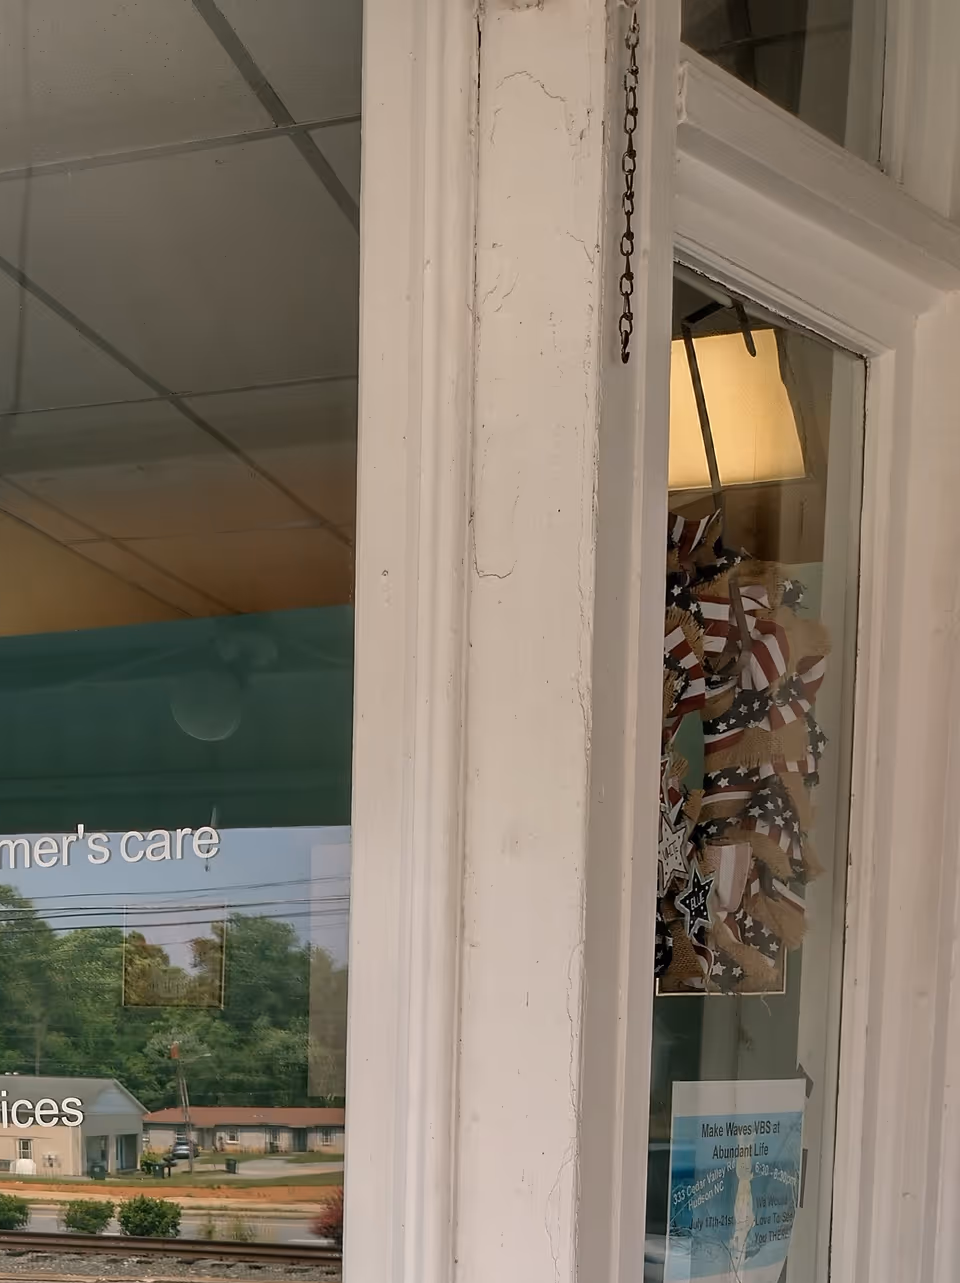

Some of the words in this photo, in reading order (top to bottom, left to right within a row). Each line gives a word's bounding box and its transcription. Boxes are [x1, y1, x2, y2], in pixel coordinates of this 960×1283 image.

[120, 826, 220, 864] care
[690, 889, 705, 911] BLUE
[701, 1123, 724, 1138] Make
[725, 1122, 752, 1137] Waves
[753, 1120, 771, 1135] VBS
[772, 1121, 781, 1134] at
[712, 1143, 753, 1160] Abundant
[754, 1142, 769, 1157] Life
[672, 1189, 686, 1205] 333
[686, 1178, 706, 1197] Cedar
[706, 1167, 726, 1185] Valley
[688, 1187, 714, 1211] Hudson
[714, 1180, 725, 1196] NC
[688, 1217, 703, 1232] July
